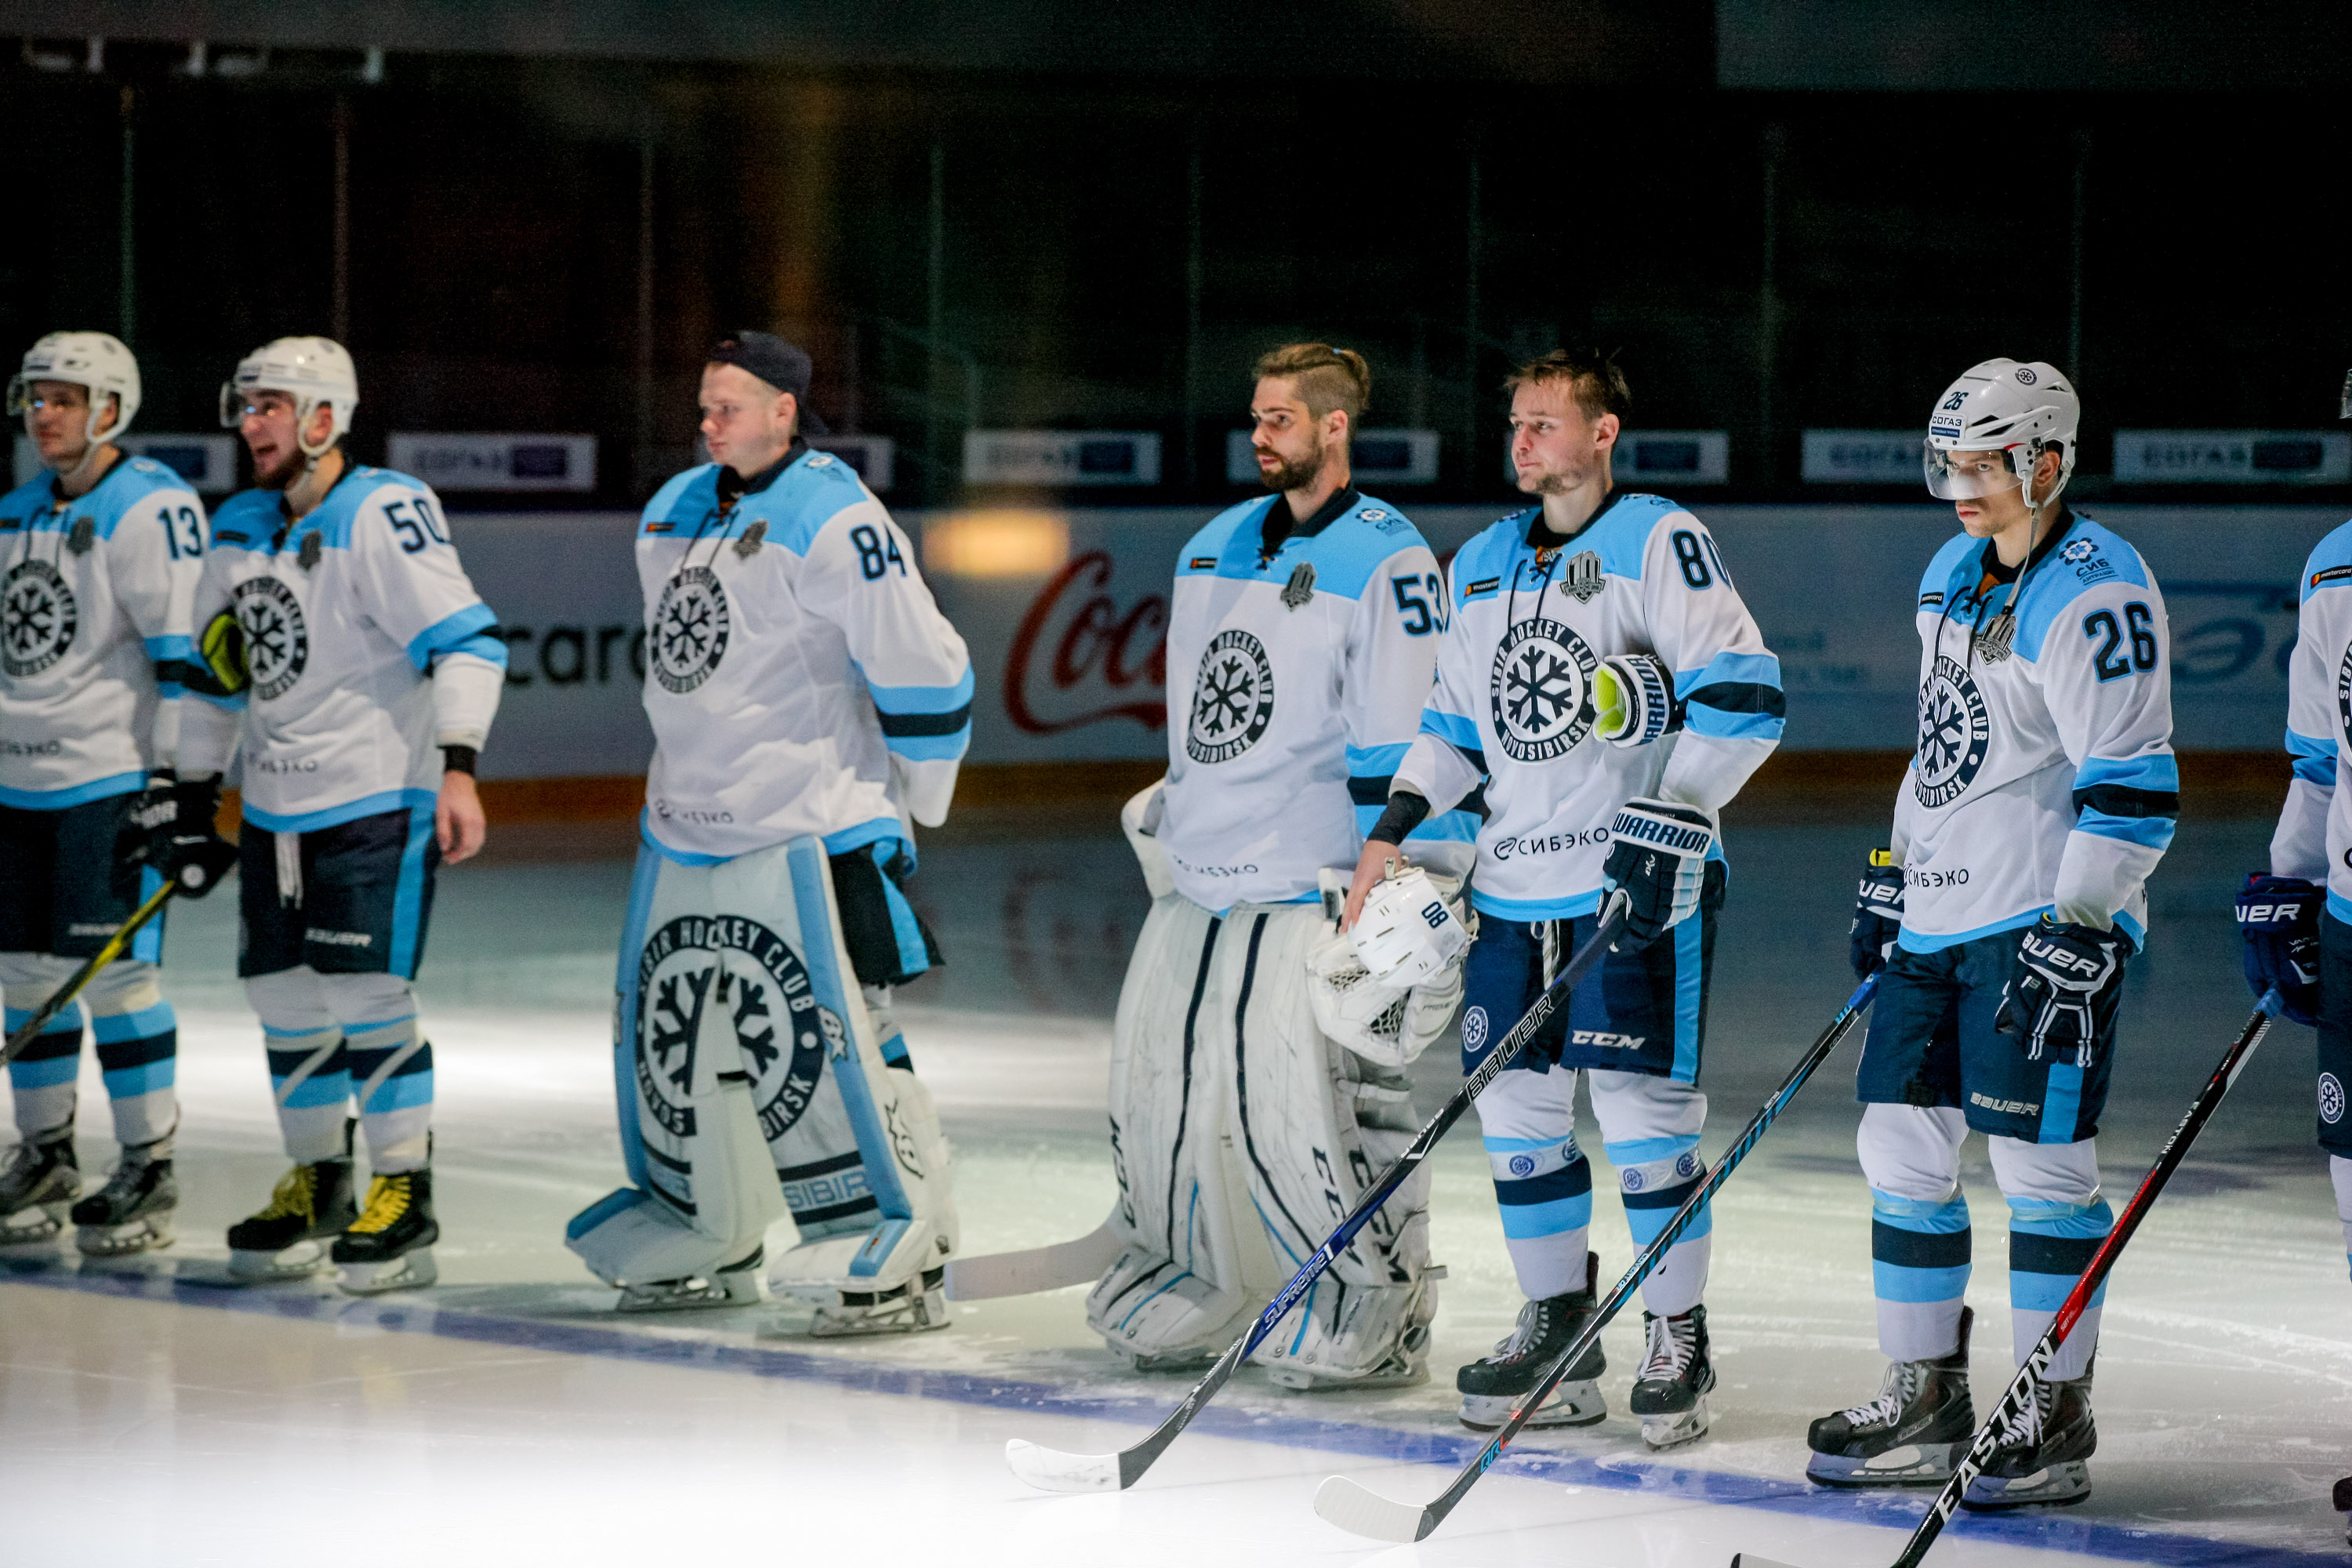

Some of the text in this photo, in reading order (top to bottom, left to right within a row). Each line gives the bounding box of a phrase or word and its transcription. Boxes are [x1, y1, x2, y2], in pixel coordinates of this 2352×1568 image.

[1932, 416, 1962, 427] СОГАЗ
[1943, 391, 1969, 411] 26
[159, 506, 202, 561] 13
[383, 499, 452, 555] 50
[851, 523, 906, 581] 84
[2076, 558, 2110, 577] СИБ
[1392, 573, 1450, 637] 53
[1216, 630, 1273, 704] HOCKEY CLUB
[1491, 619, 1599, 698] SIBIR HOCKEY CLUB
[2082, 601, 2158, 684] 26
[1501, 716, 1592, 760] NOVOSIBIRSK
[1965, 691, 1988, 742] CLUB
[1518, 826, 1610, 856] СИБЭКО
[1612, 811, 1711, 855] WARRIOR
[1907, 869, 1969, 888] СИБЭКО
[763, 942, 816, 1014] CLUB
[1572, 1029, 1646, 1050] CCM
[1970, 1092, 2039, 1116] BAUER
[2161, 1101, 2201, 1155] EASTON
[1265, 1252, 1327, 1330] SUPREME
[1937, 1335, 2056, 1526] EASTON
